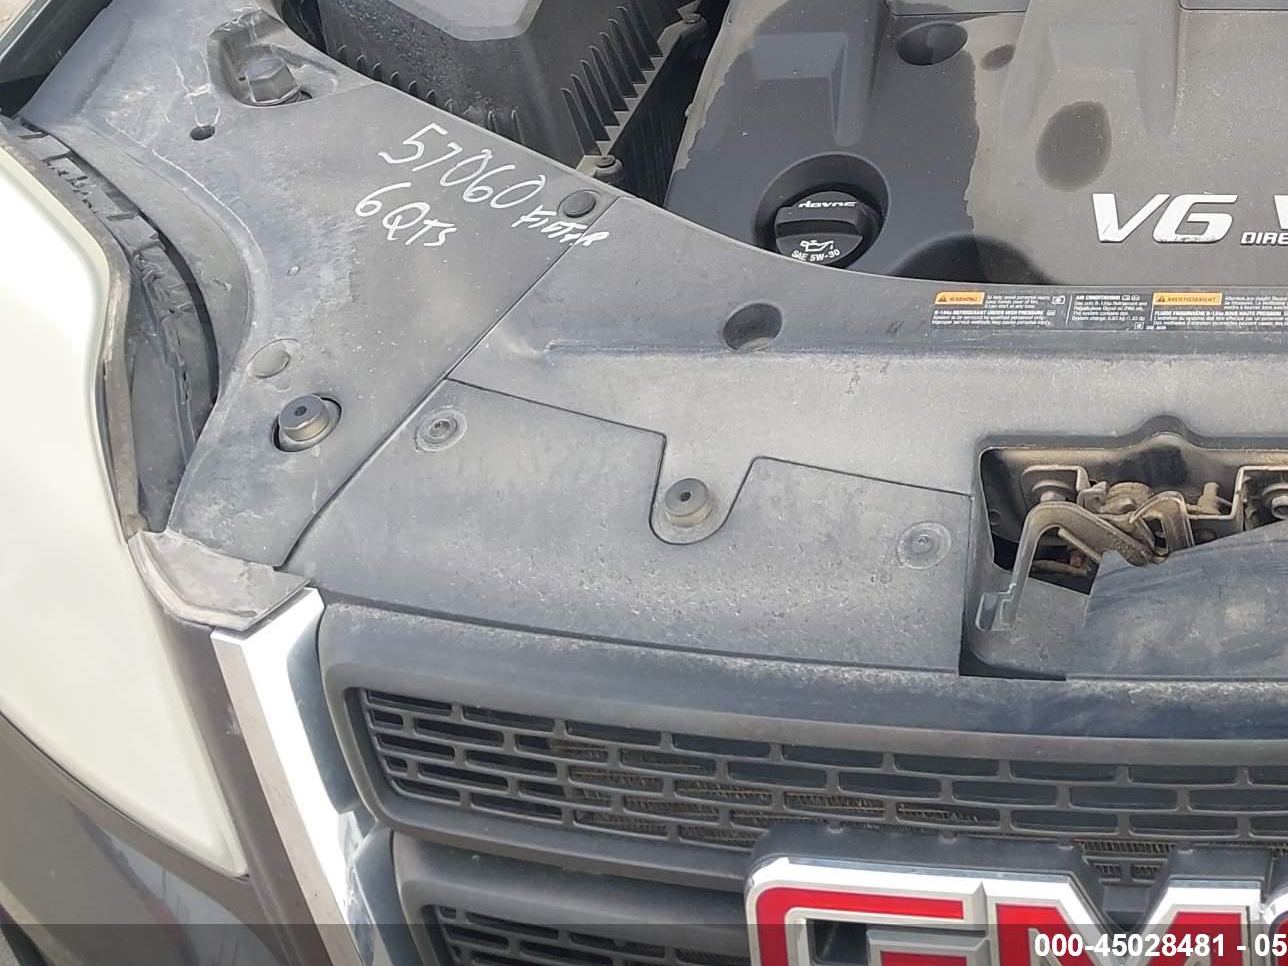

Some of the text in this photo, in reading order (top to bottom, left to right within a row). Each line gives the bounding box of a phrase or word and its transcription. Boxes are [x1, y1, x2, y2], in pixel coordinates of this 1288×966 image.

[377, 122, 546, 210] 57060
[1092, 193, 1239, 244] V6
[791, 248, 841, 262] SAE 5W-30
